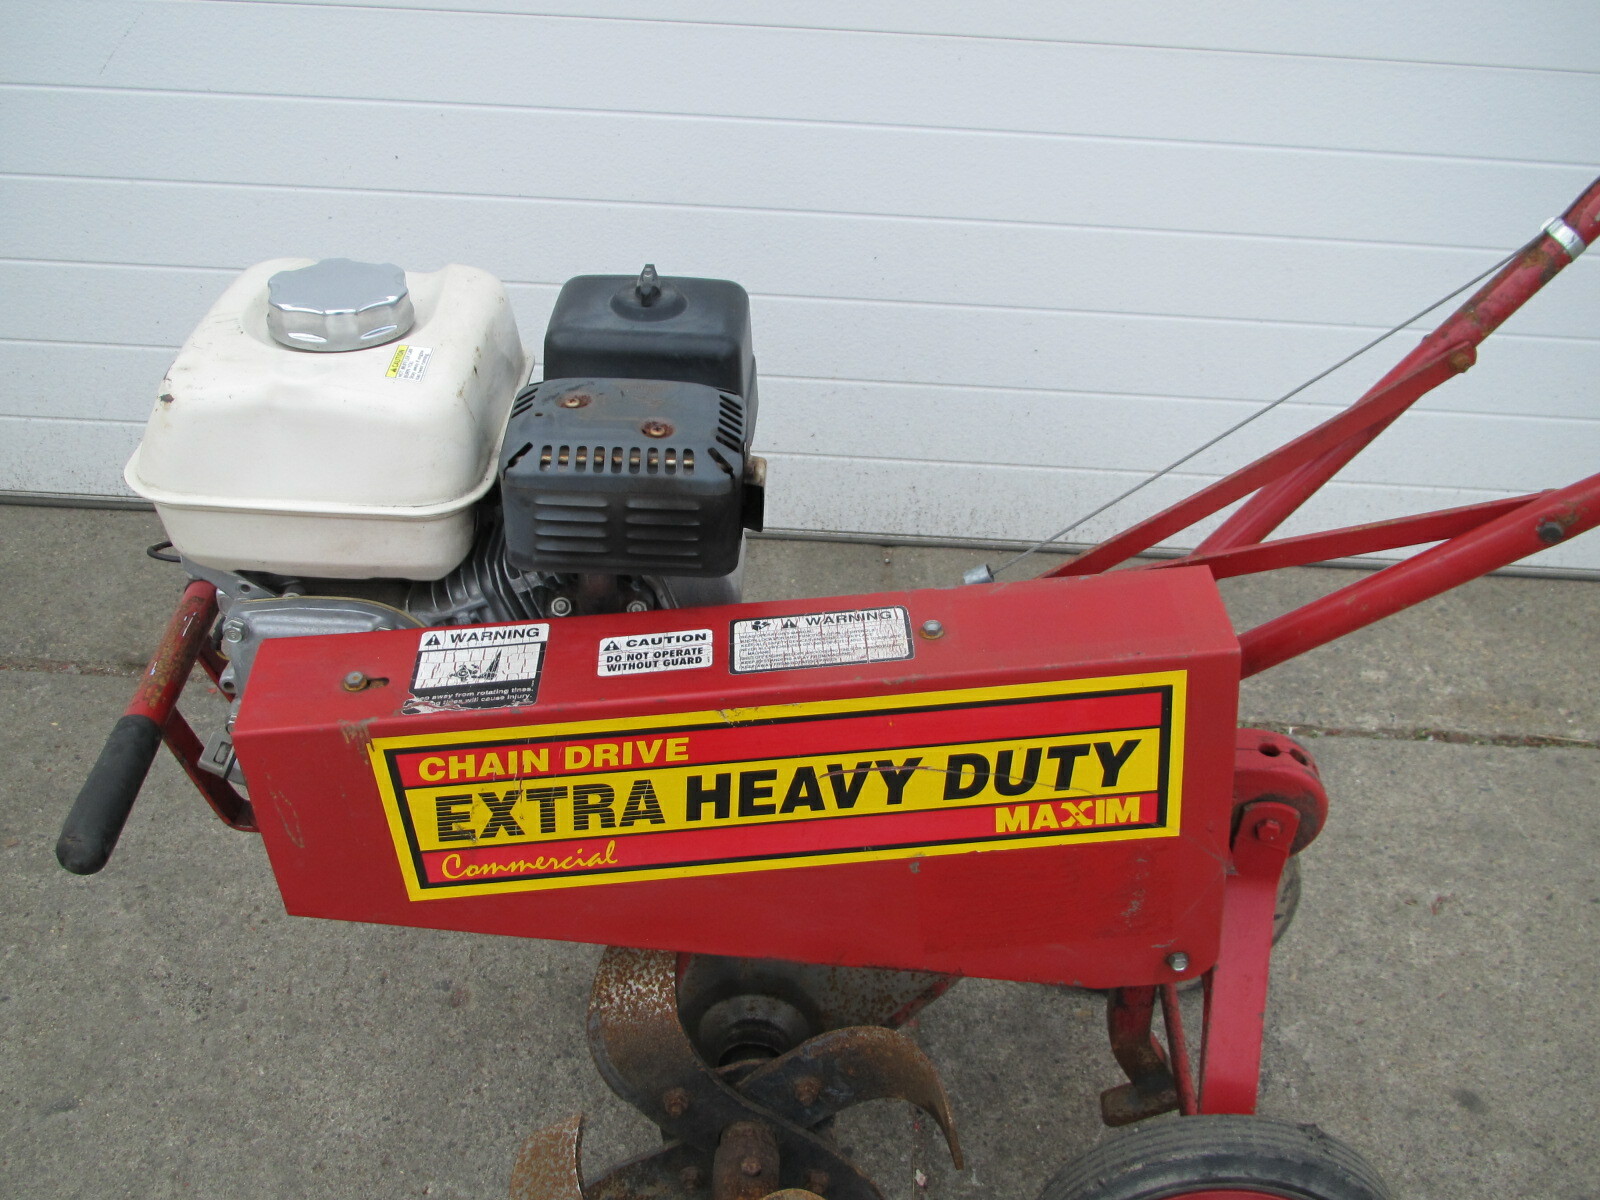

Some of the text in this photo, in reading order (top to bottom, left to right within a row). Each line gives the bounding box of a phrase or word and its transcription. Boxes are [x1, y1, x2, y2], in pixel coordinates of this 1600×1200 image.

[805, 611, 892, 626] WARNING
[450, 627, 540, 644] WARNING
[625, 633, 707, 648] CAUTION
[606, 647, 704, 663] DO NOT OPERATE
[606, 660, 659, 672] WITHOUT
[662, 656, 703, 667] GUARD
[432, 693, 453, 701] away
[476, 688, 509, 697] rotating
[418, 737, 690, 782] CHAIN DRIVE
[435, 738, 1142, 843] EXTRA HEAVY DUTY
[995, 796, 1141, 833] MAXIM
[441, 840, 618, 879] Commercial
